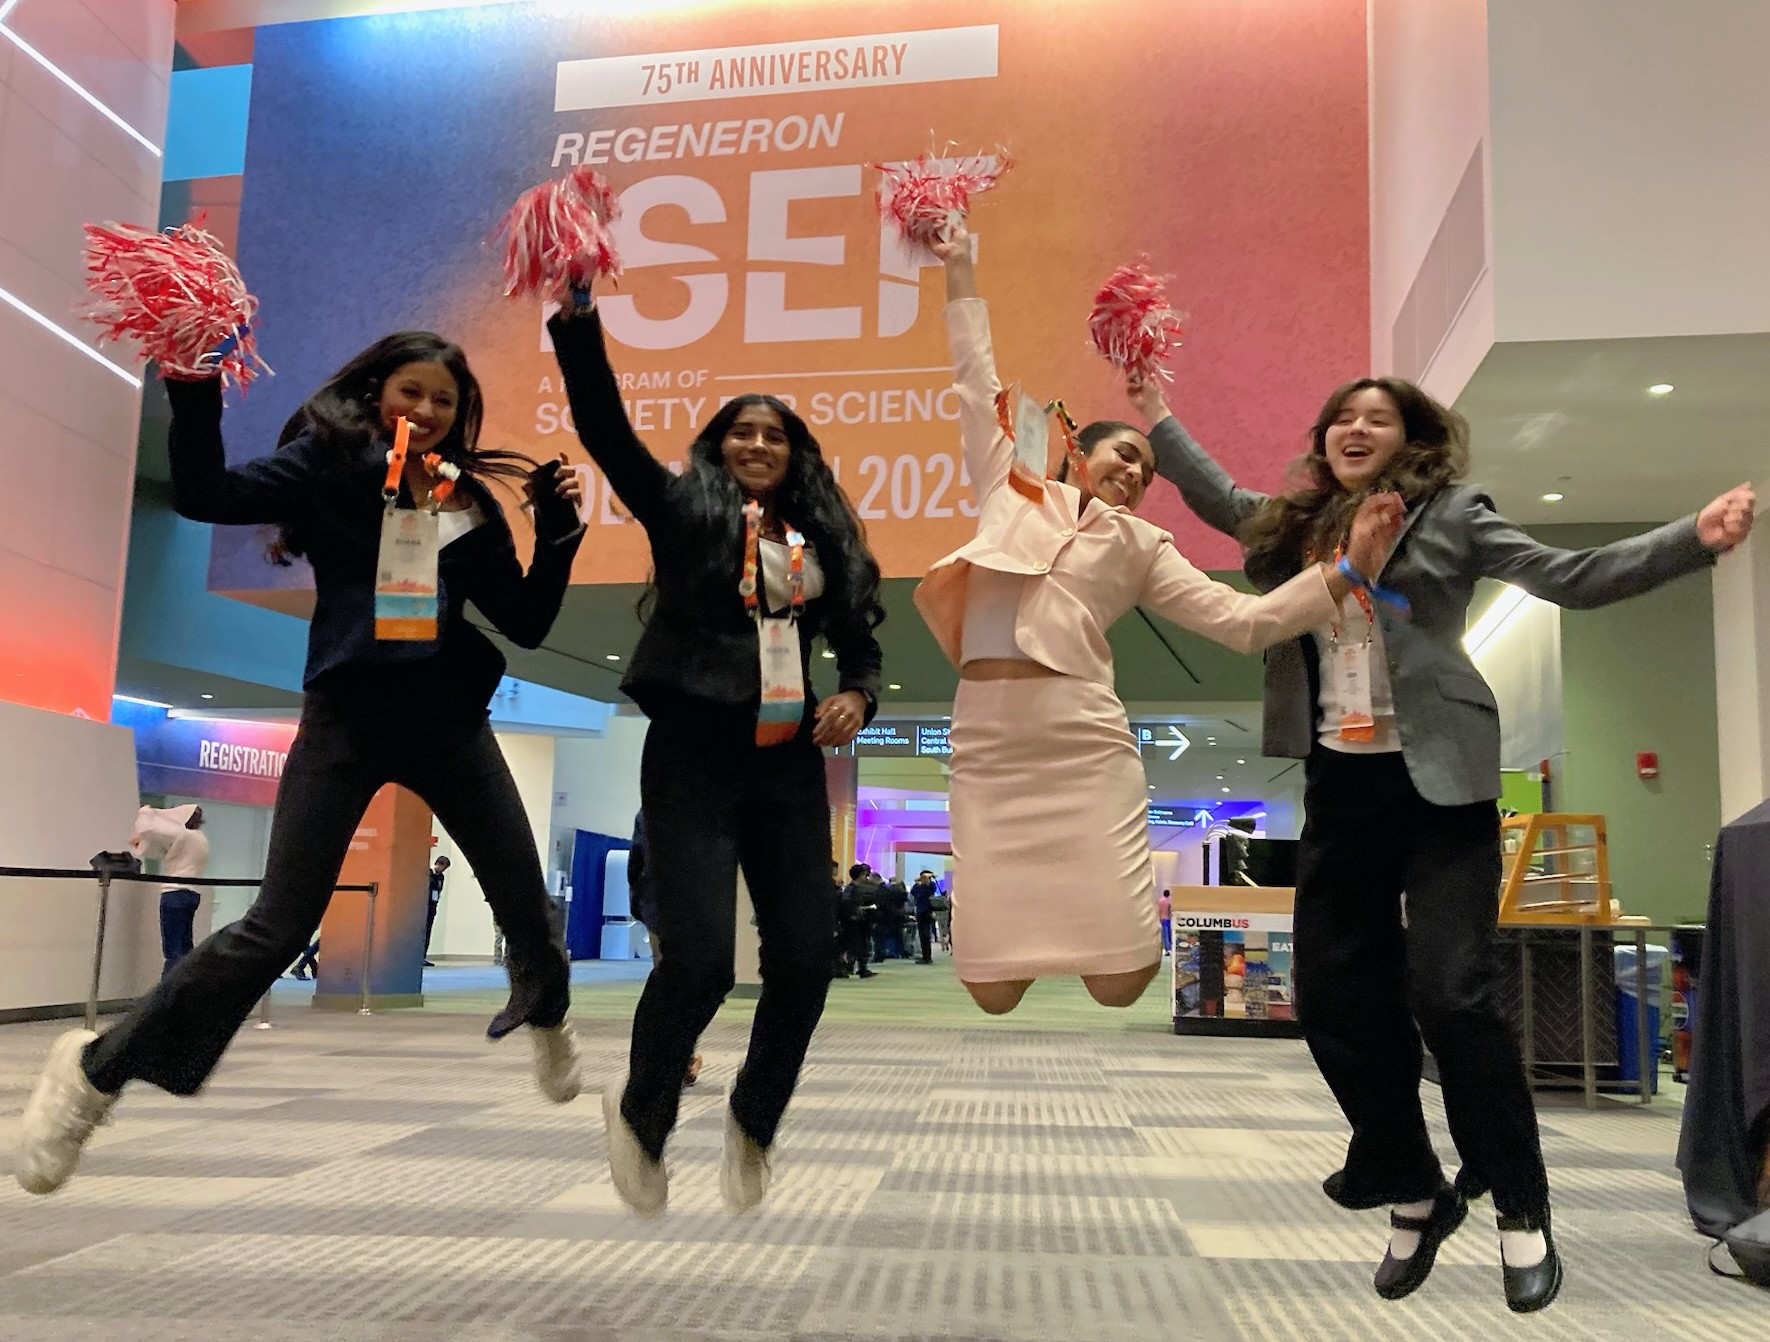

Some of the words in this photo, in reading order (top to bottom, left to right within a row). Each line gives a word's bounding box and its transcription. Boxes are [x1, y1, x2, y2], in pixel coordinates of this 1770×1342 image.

[641, 60, 700, 96] 75TH
[709, 43, 907, 91] ANNIVERSARY
[551, 112, 845, 168] REGENERON
[537, 376, 553, 394] A
[677, 369, 710, 388] OF
[809, 387, 962, 426] SCIENC
[1142, 729, 1152, 741] B
